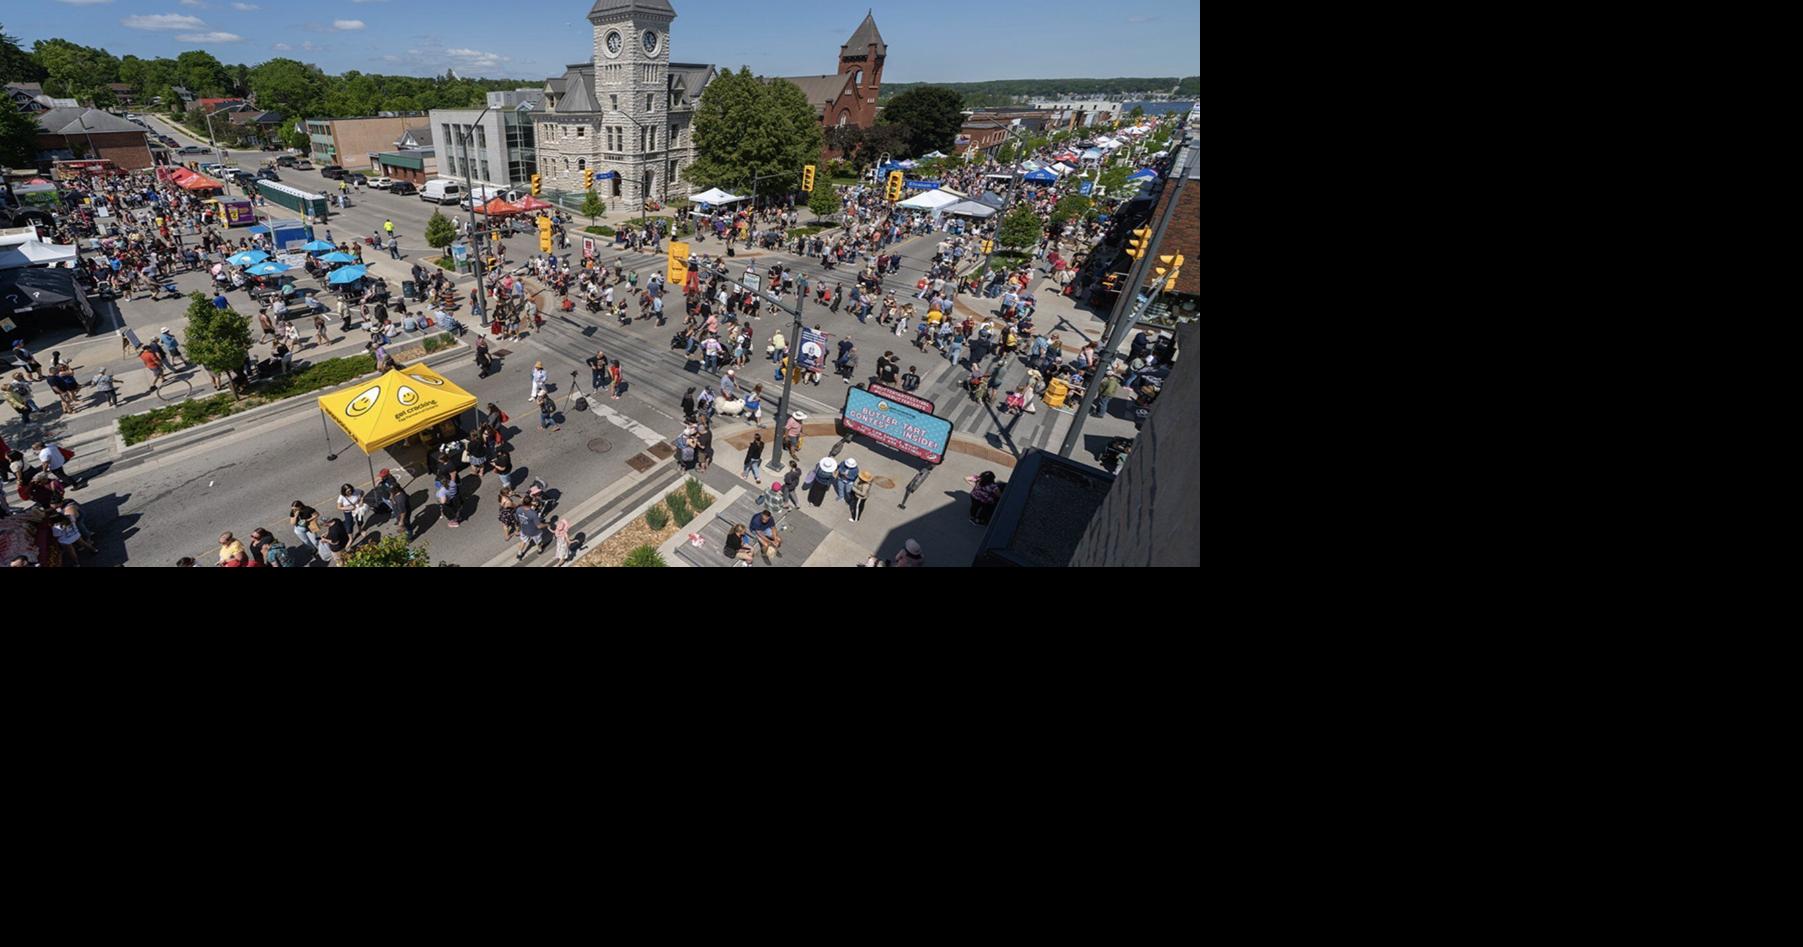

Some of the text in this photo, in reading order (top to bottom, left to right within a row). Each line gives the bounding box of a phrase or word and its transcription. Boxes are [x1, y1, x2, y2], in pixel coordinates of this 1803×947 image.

[395, 410, 406, 420] get
[850, 410, 889, 429] CONTEST
[903, 431, 939, 449] INSIDE!
[862, 407, 897, 425] BUTTER
[903, 423, 927, 437] TART
